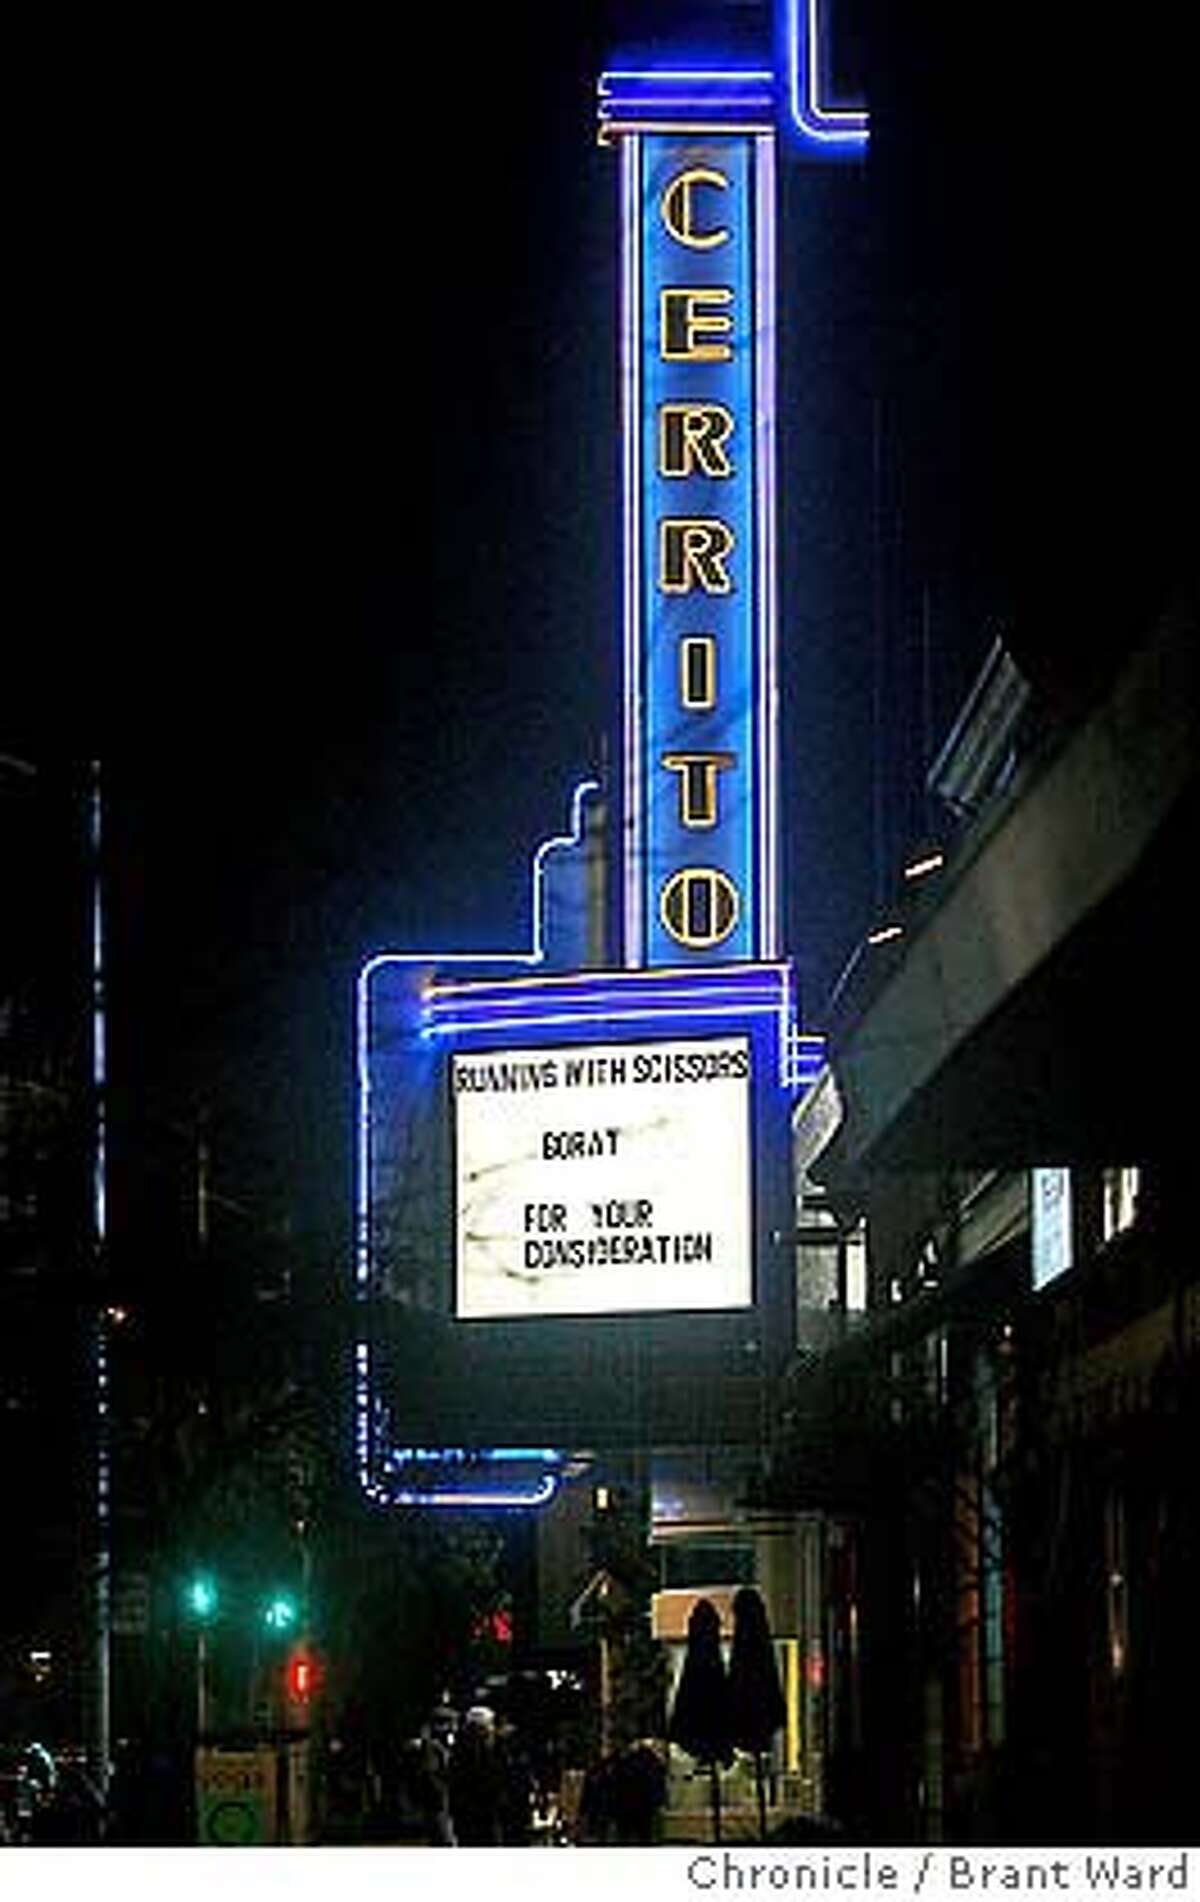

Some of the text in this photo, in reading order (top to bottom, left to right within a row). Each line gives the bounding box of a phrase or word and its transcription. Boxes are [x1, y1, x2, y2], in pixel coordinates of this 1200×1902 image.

[658, 166, 740, 951] CERRITO
[455, 1048, 749, 1093] RUNNING WITH SCISSORS
[542, 1130, 619, 1161] BORAT
[523, 1198, 654, 1233] FOR YOUR
[523, 1232, 713, 1269] CONSIDERATION
